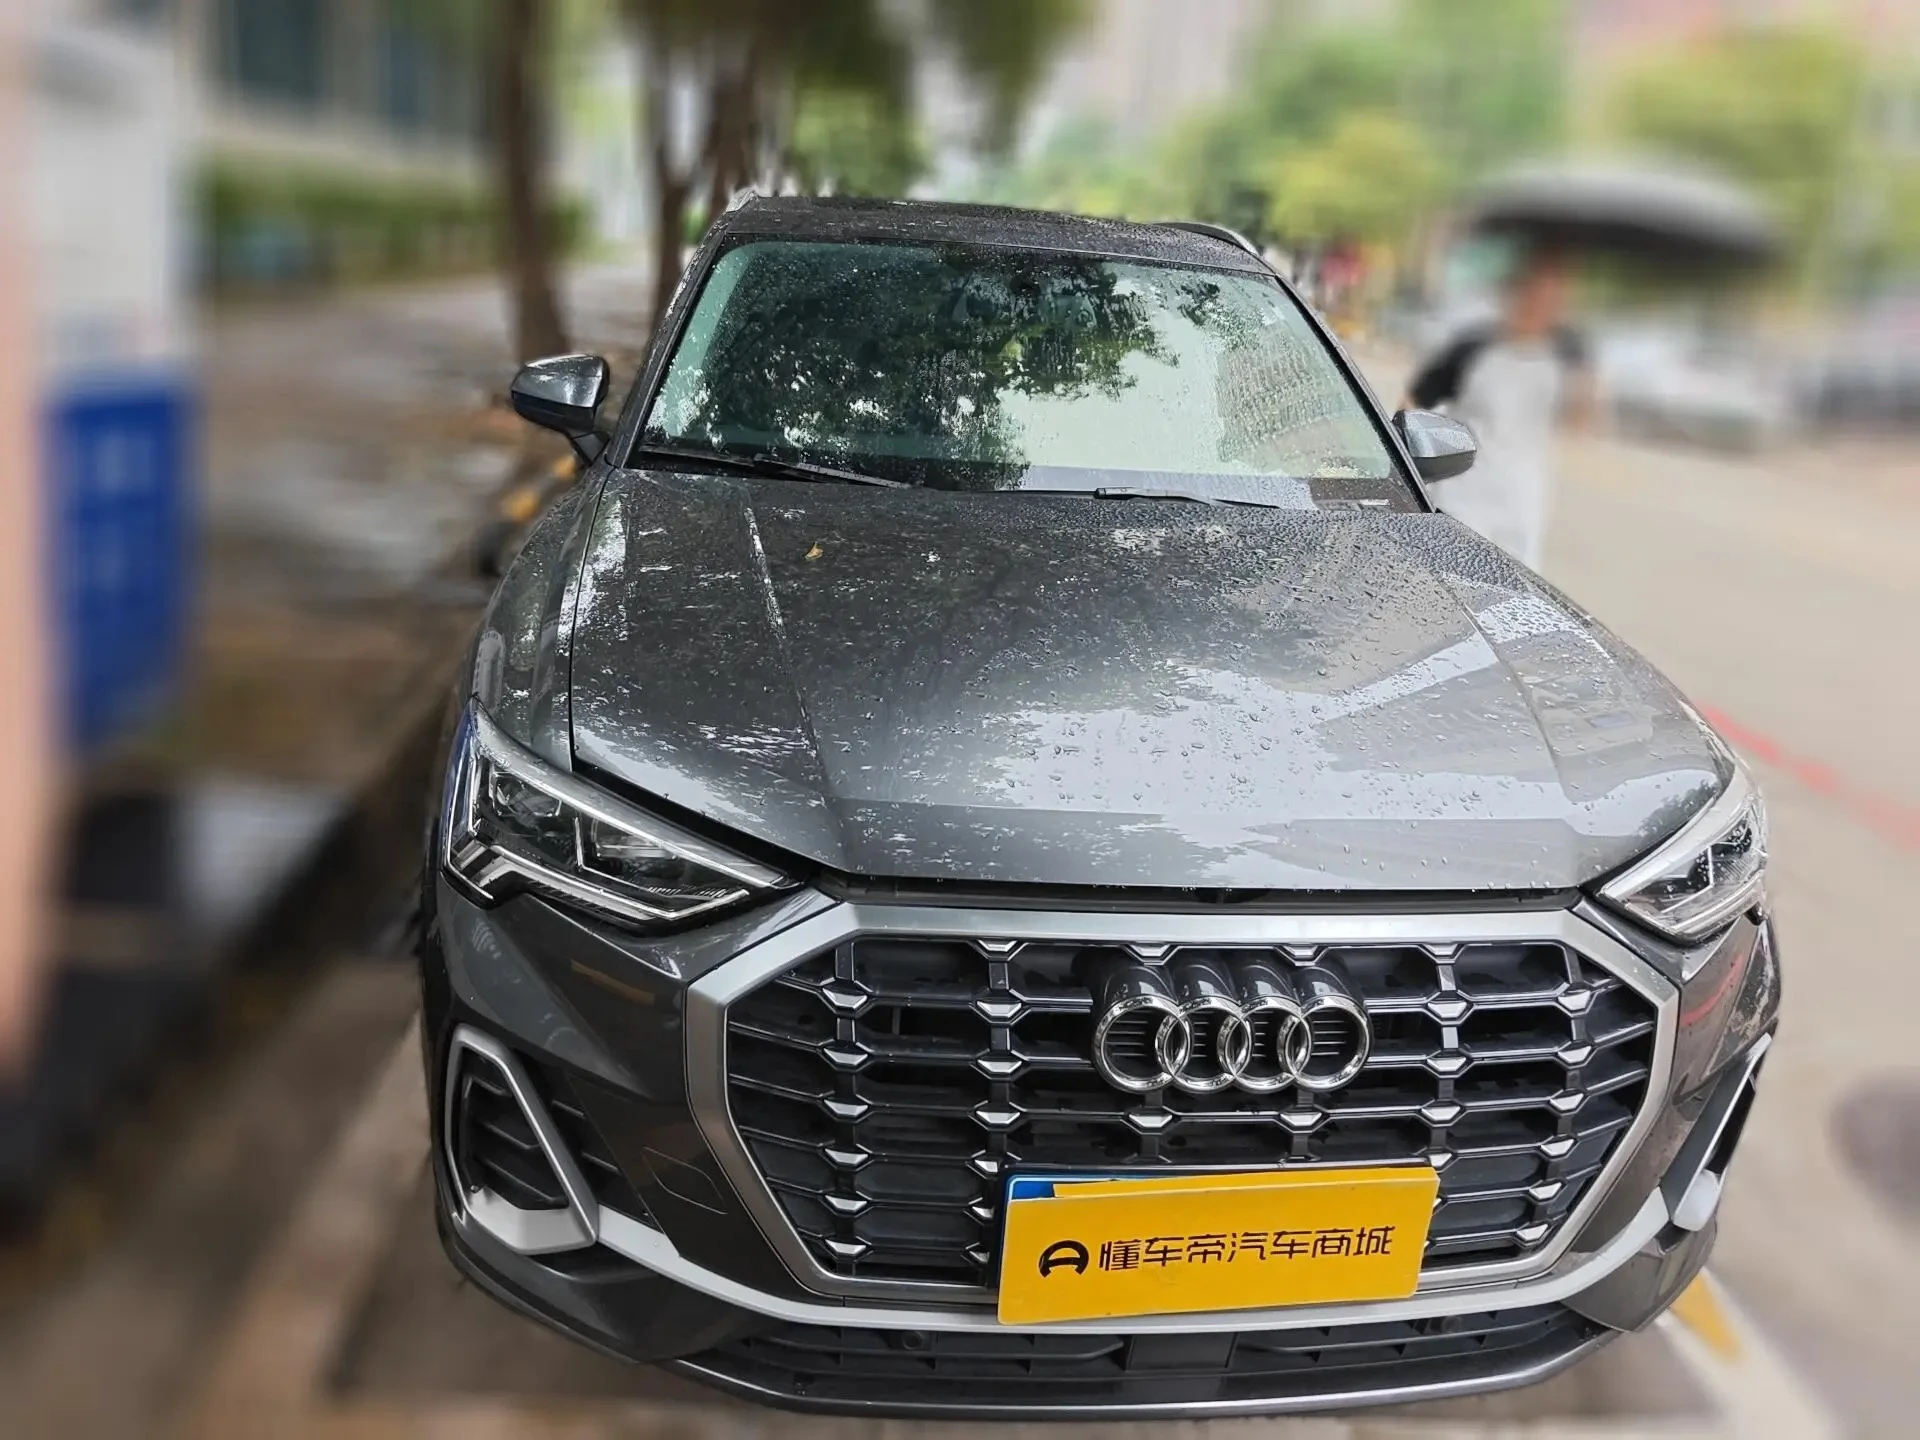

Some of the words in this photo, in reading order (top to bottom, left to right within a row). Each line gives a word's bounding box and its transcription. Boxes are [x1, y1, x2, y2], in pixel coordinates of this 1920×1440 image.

[1099, 1225, 1395, 1272] 懂车帝汽车商城
